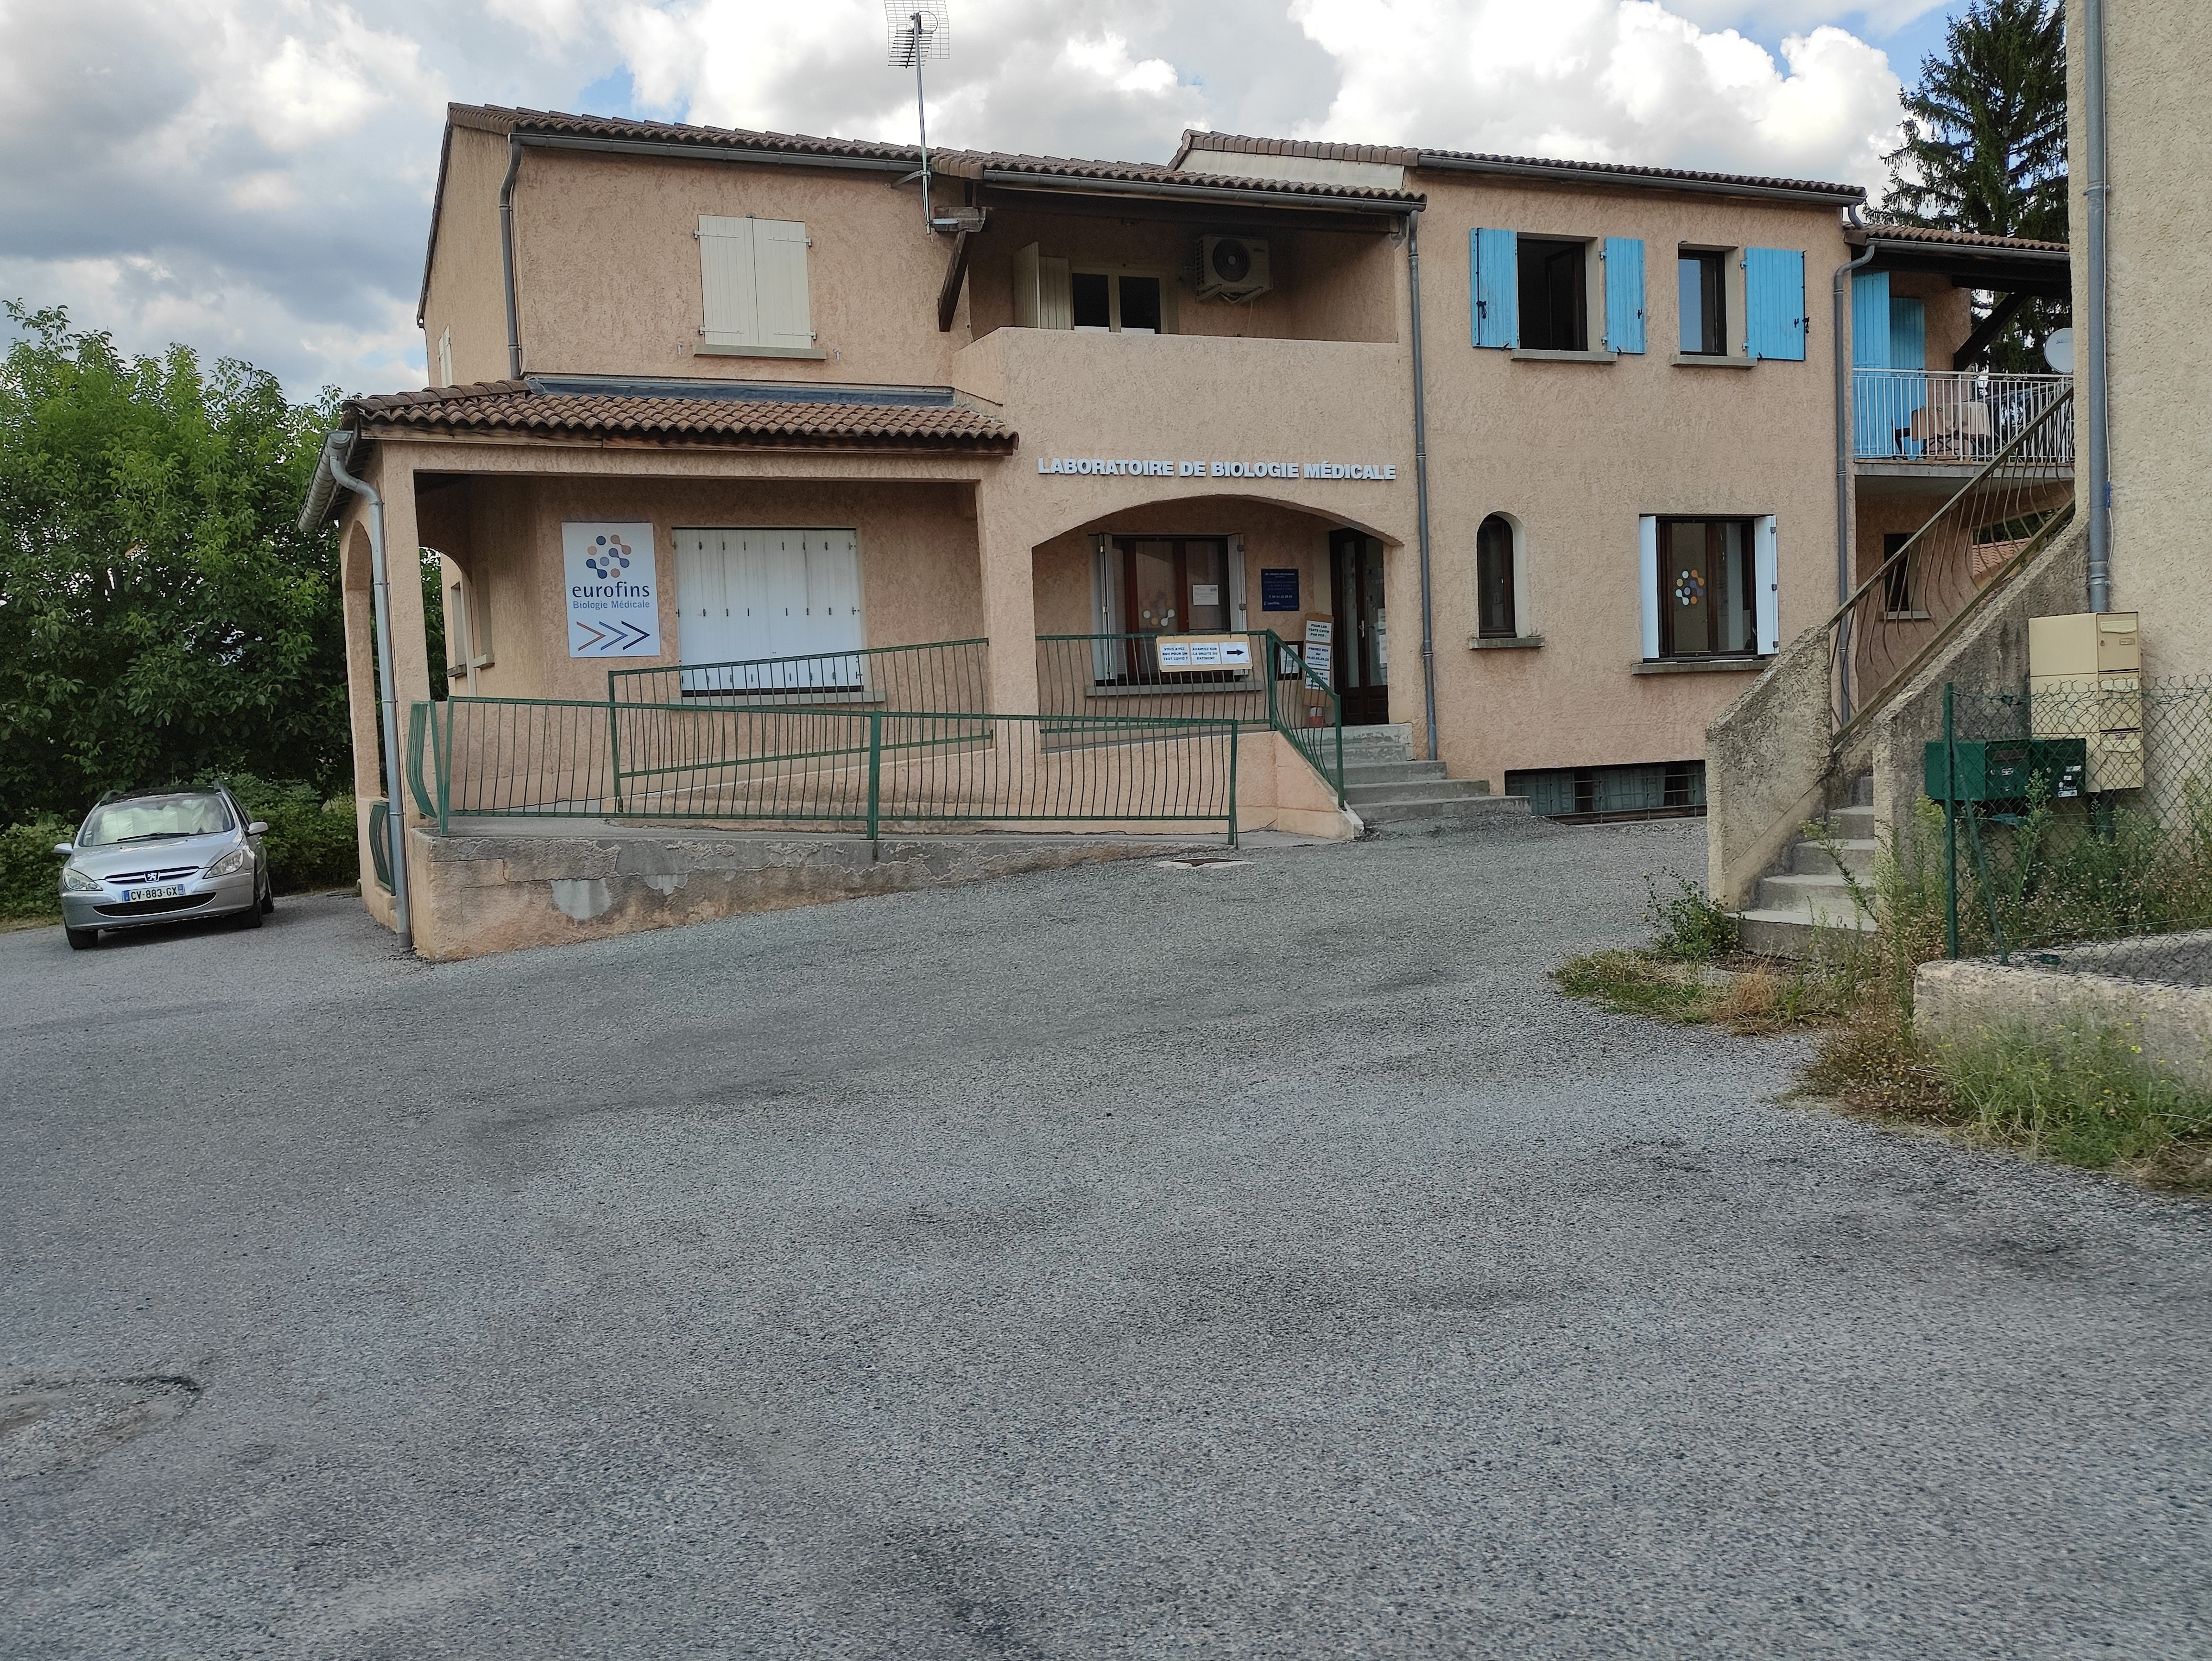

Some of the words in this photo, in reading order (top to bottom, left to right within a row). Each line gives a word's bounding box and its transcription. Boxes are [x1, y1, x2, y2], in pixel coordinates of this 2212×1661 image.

[1037, 457, 1174, 476] LABORATOIRE
[1179, 461, 1206, 477] DE
[1210, 461, 1300, 478] BIOLOGIE
[1303, 460, 1397, 479] MÉDICALE
[572, 581, 650, 598] eurofins
[573, 601, 608, 610] Biologie
[131, 887, 177, 900] CV-883-GX
